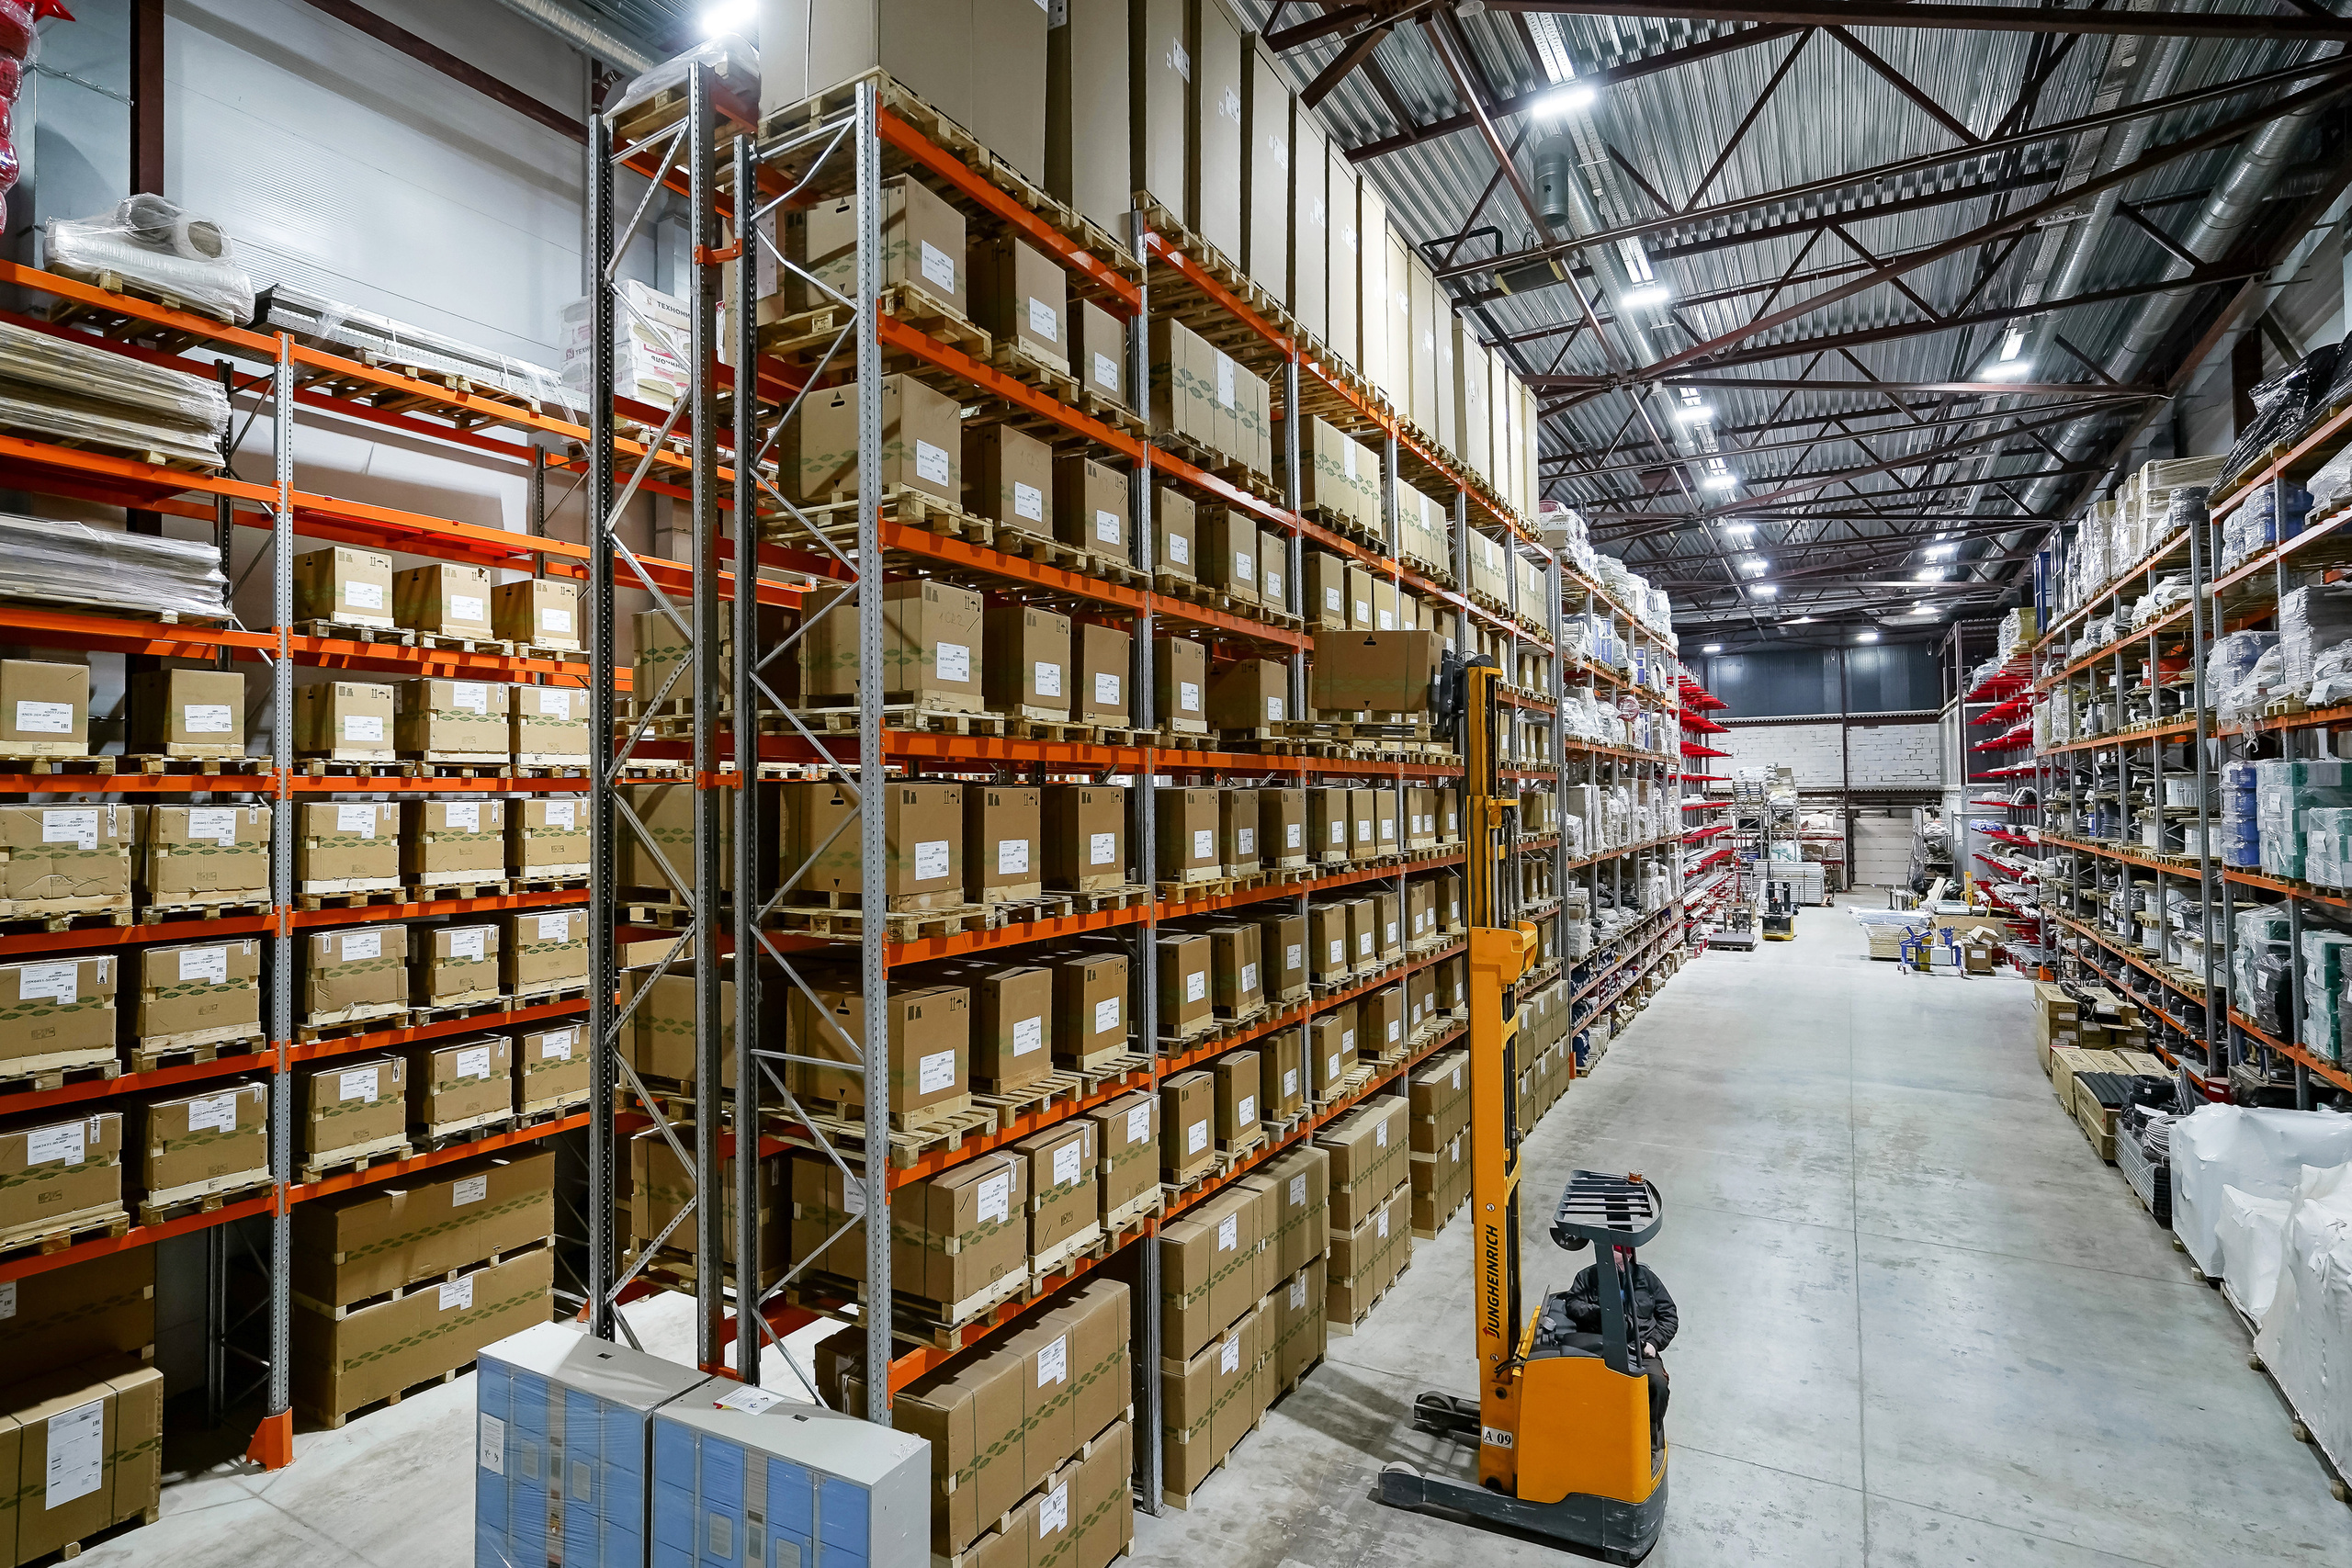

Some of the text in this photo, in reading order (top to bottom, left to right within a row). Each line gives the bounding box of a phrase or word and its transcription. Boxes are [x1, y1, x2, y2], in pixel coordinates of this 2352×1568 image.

[1486, 1224, 1499, 1339] JUNGHEINRICH
[1485, 1430, 1511, 1445] A 09
